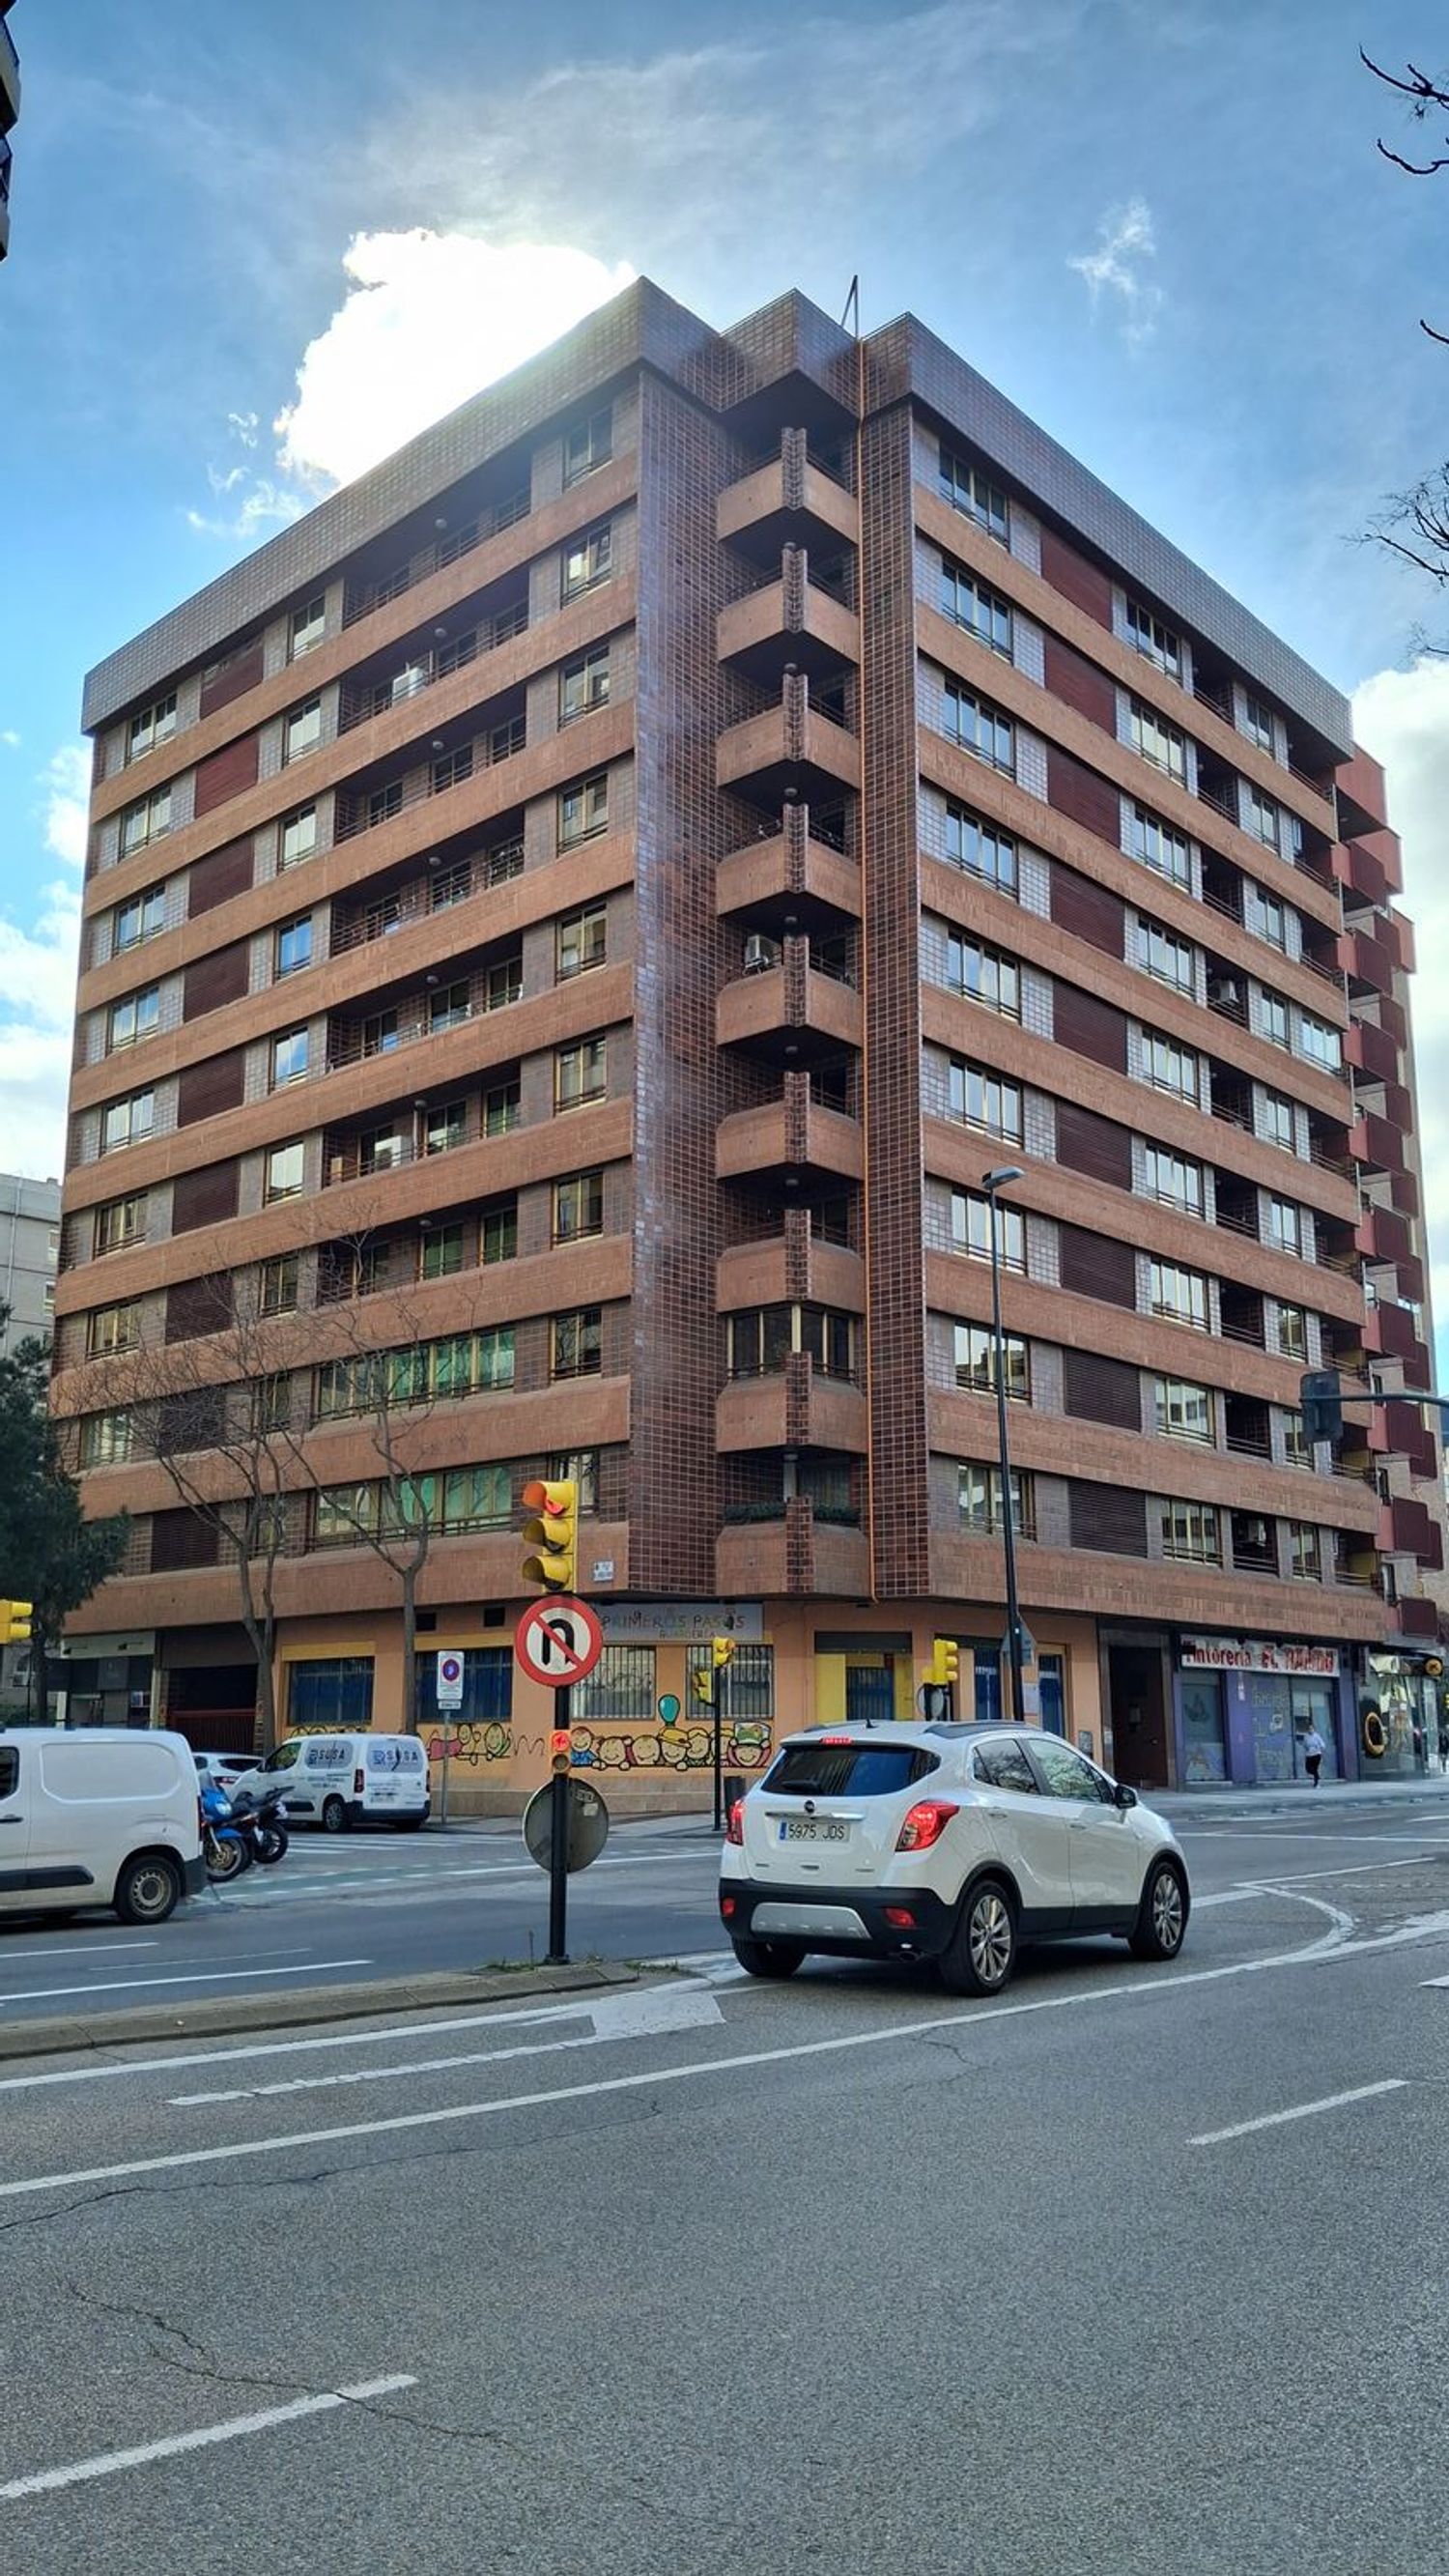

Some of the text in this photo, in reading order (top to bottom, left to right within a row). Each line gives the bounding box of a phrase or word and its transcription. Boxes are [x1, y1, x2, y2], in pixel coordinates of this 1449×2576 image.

[602, 1614, 687, 1630] PRIMEROS
[788, 1822, 844, 1841] 5975 JDS
